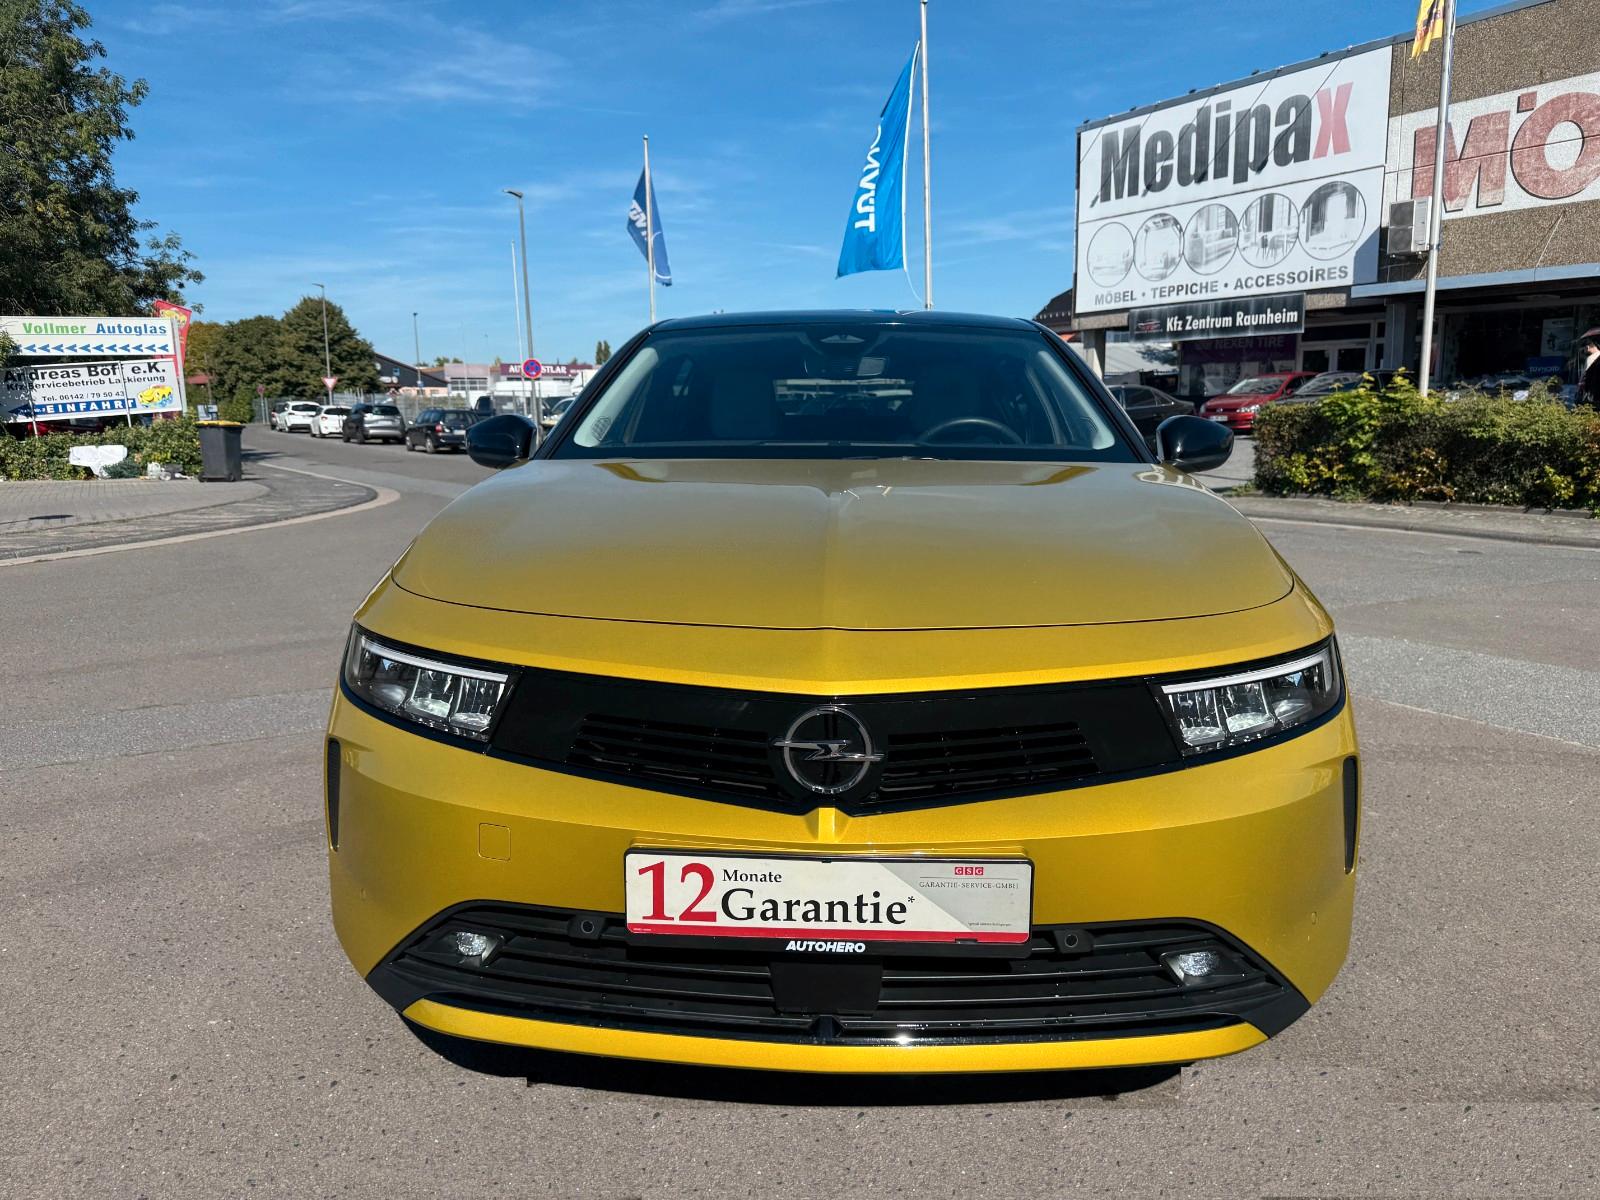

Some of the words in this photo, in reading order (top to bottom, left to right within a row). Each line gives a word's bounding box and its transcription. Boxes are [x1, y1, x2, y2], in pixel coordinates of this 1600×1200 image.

[1100, 82, 1353, 203] Medipax
[1094, 290, 1137, 306] MÖBEL
[1151, 281, 1219, 299] TEPPICHE
[22, 322, 87, 334] Vollmer
[95, 322, 167, 336] Autoglas
[1166, 316, 1183, 332] Kfz
[1184, 315, 1232, 330] Zentrum
[1236, 307, 1299, 327] Raunheim
[1257, 335, 1284, 348] TIRE
[4, 368, 81, 382] Andreas
[131, 361, 166, 374] e.K.
[723, 869, 782, 882] Monate
[638, 860, 717, 922] 12
[785, 941, 866, 953] AUTOHERO
